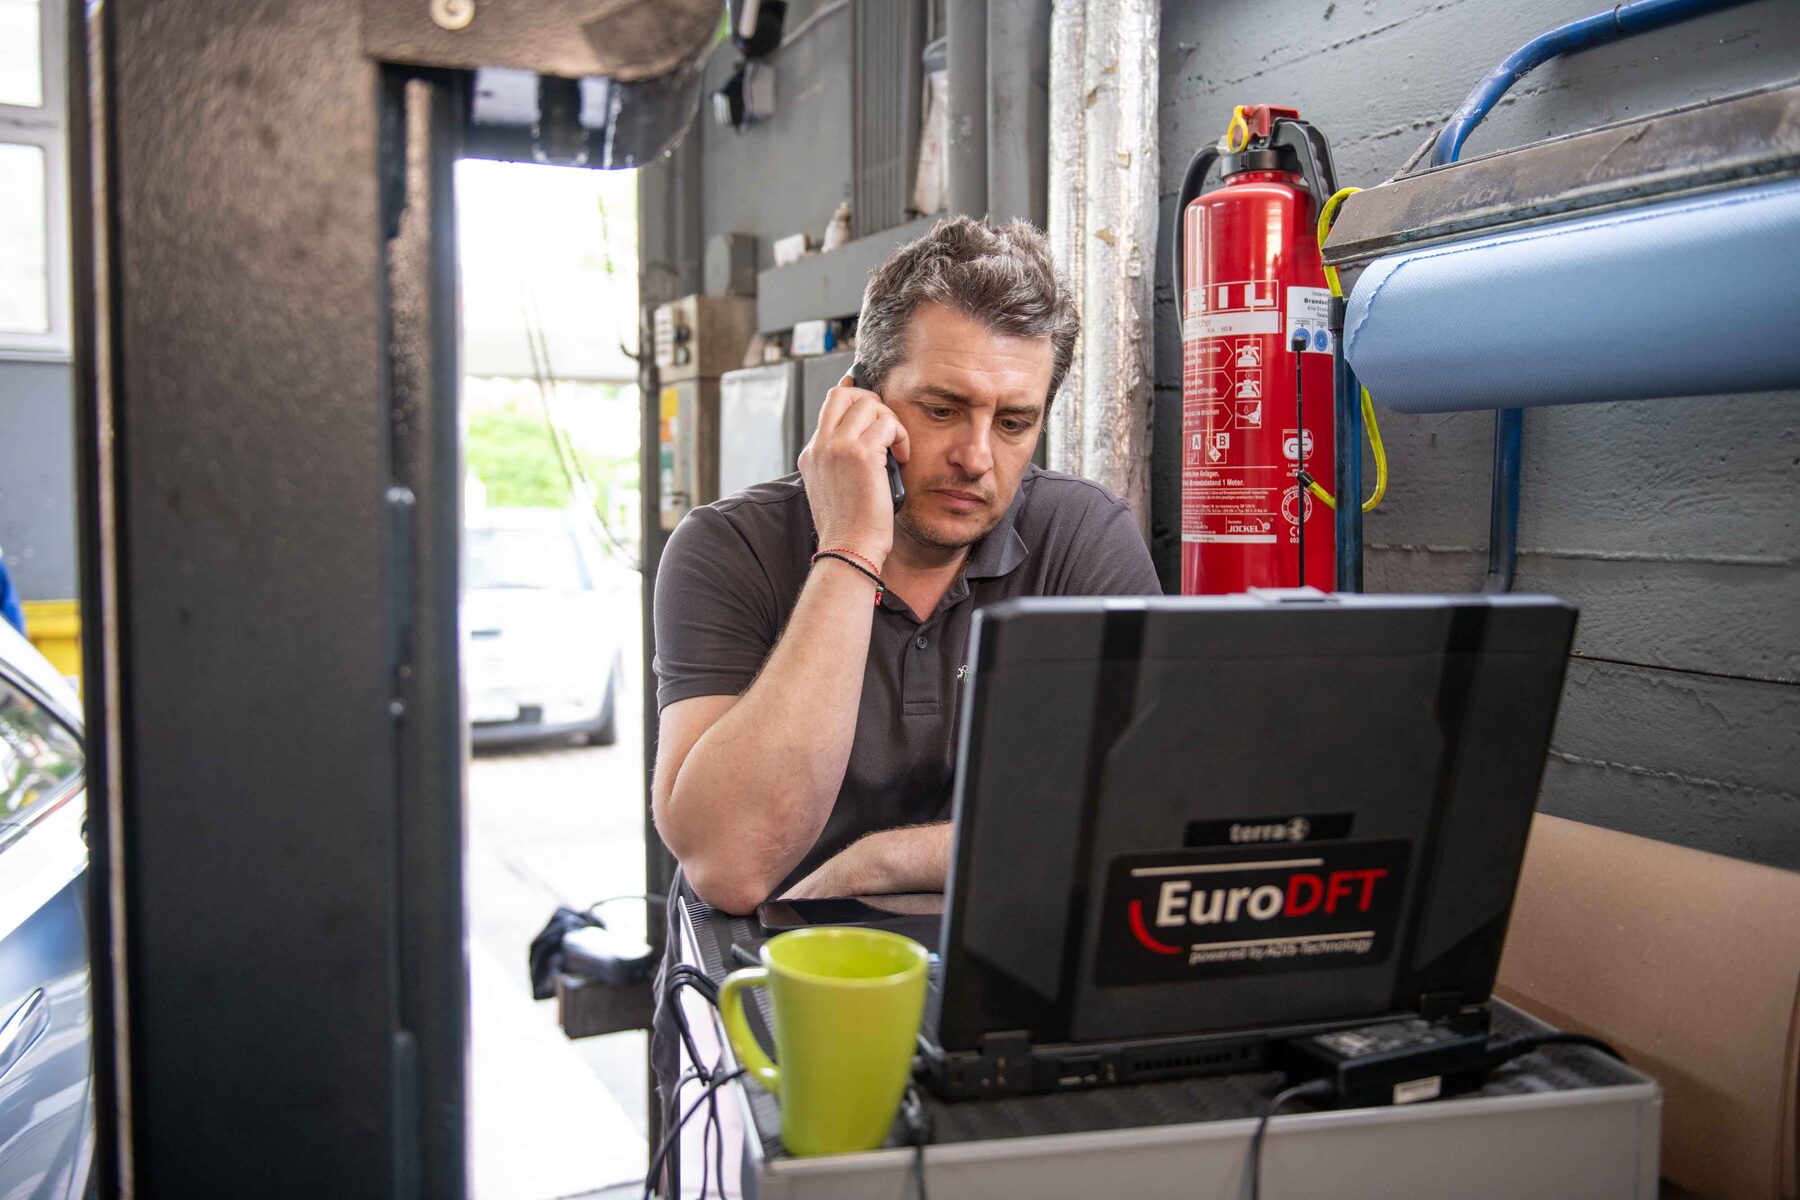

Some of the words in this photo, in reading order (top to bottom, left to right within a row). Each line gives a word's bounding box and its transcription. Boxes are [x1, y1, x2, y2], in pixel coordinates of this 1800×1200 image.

[1227, 525, 1258, 533] JOCKEL
[1229, 823, 1286, 843] terra
[1156, 868, 1387, 927] EuroDFT
[1189, 947, 1246, 966] powered
[1248, 945, 1264, 961] by
[1300, 938, 1374, 954] Technology
